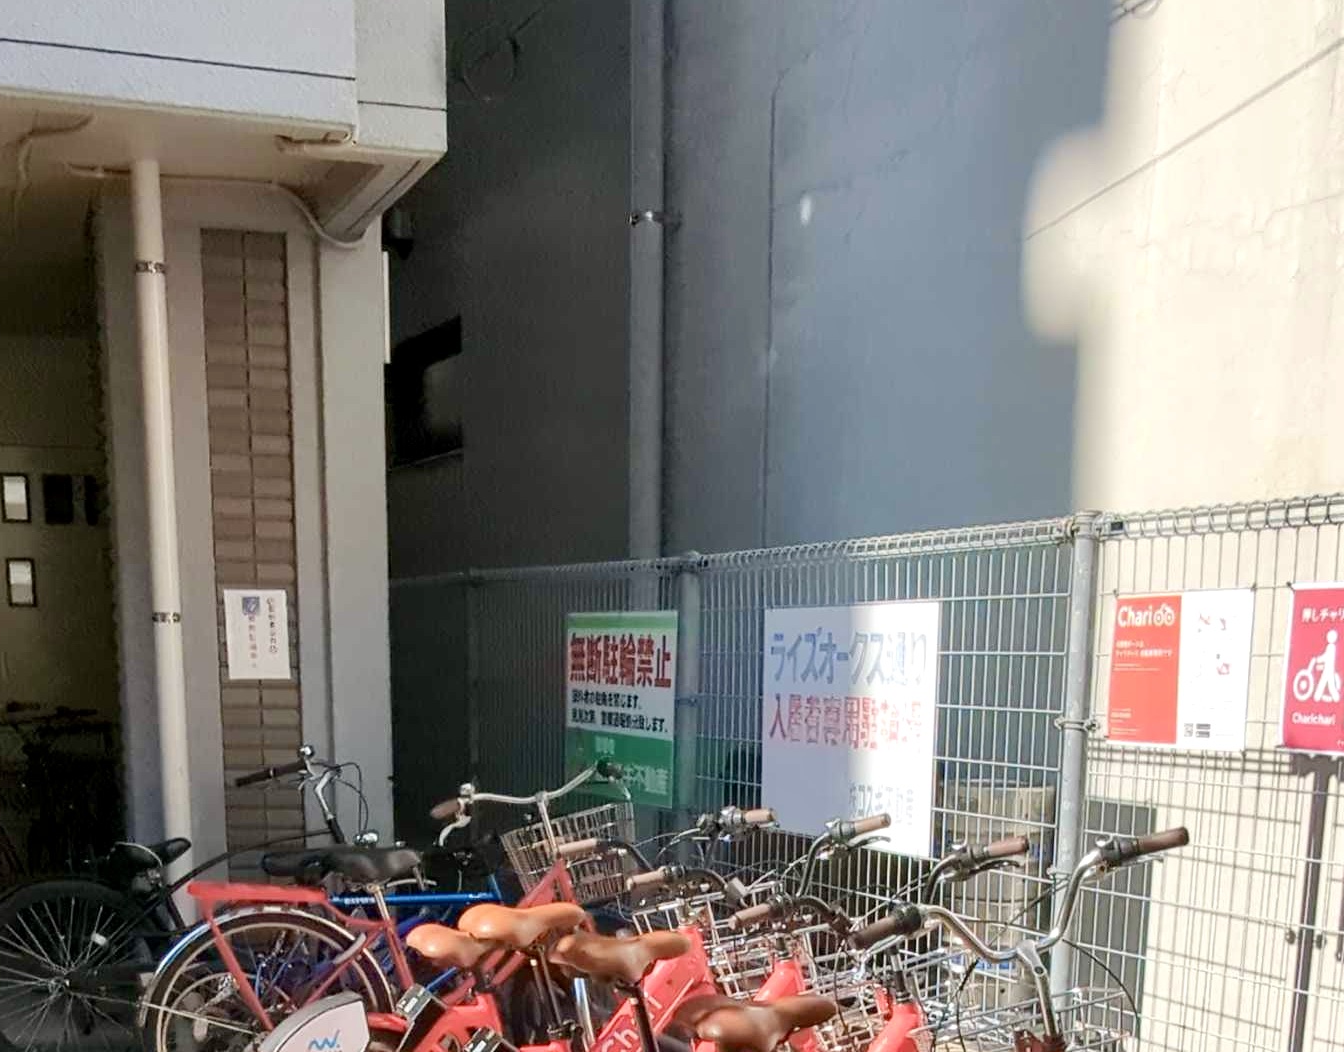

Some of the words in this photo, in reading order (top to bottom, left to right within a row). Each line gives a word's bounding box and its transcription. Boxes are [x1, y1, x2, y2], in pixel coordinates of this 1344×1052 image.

[1118, 605, 1153, 628] Chari
[570, 632, 672, 689] 無断駐輪禁止
